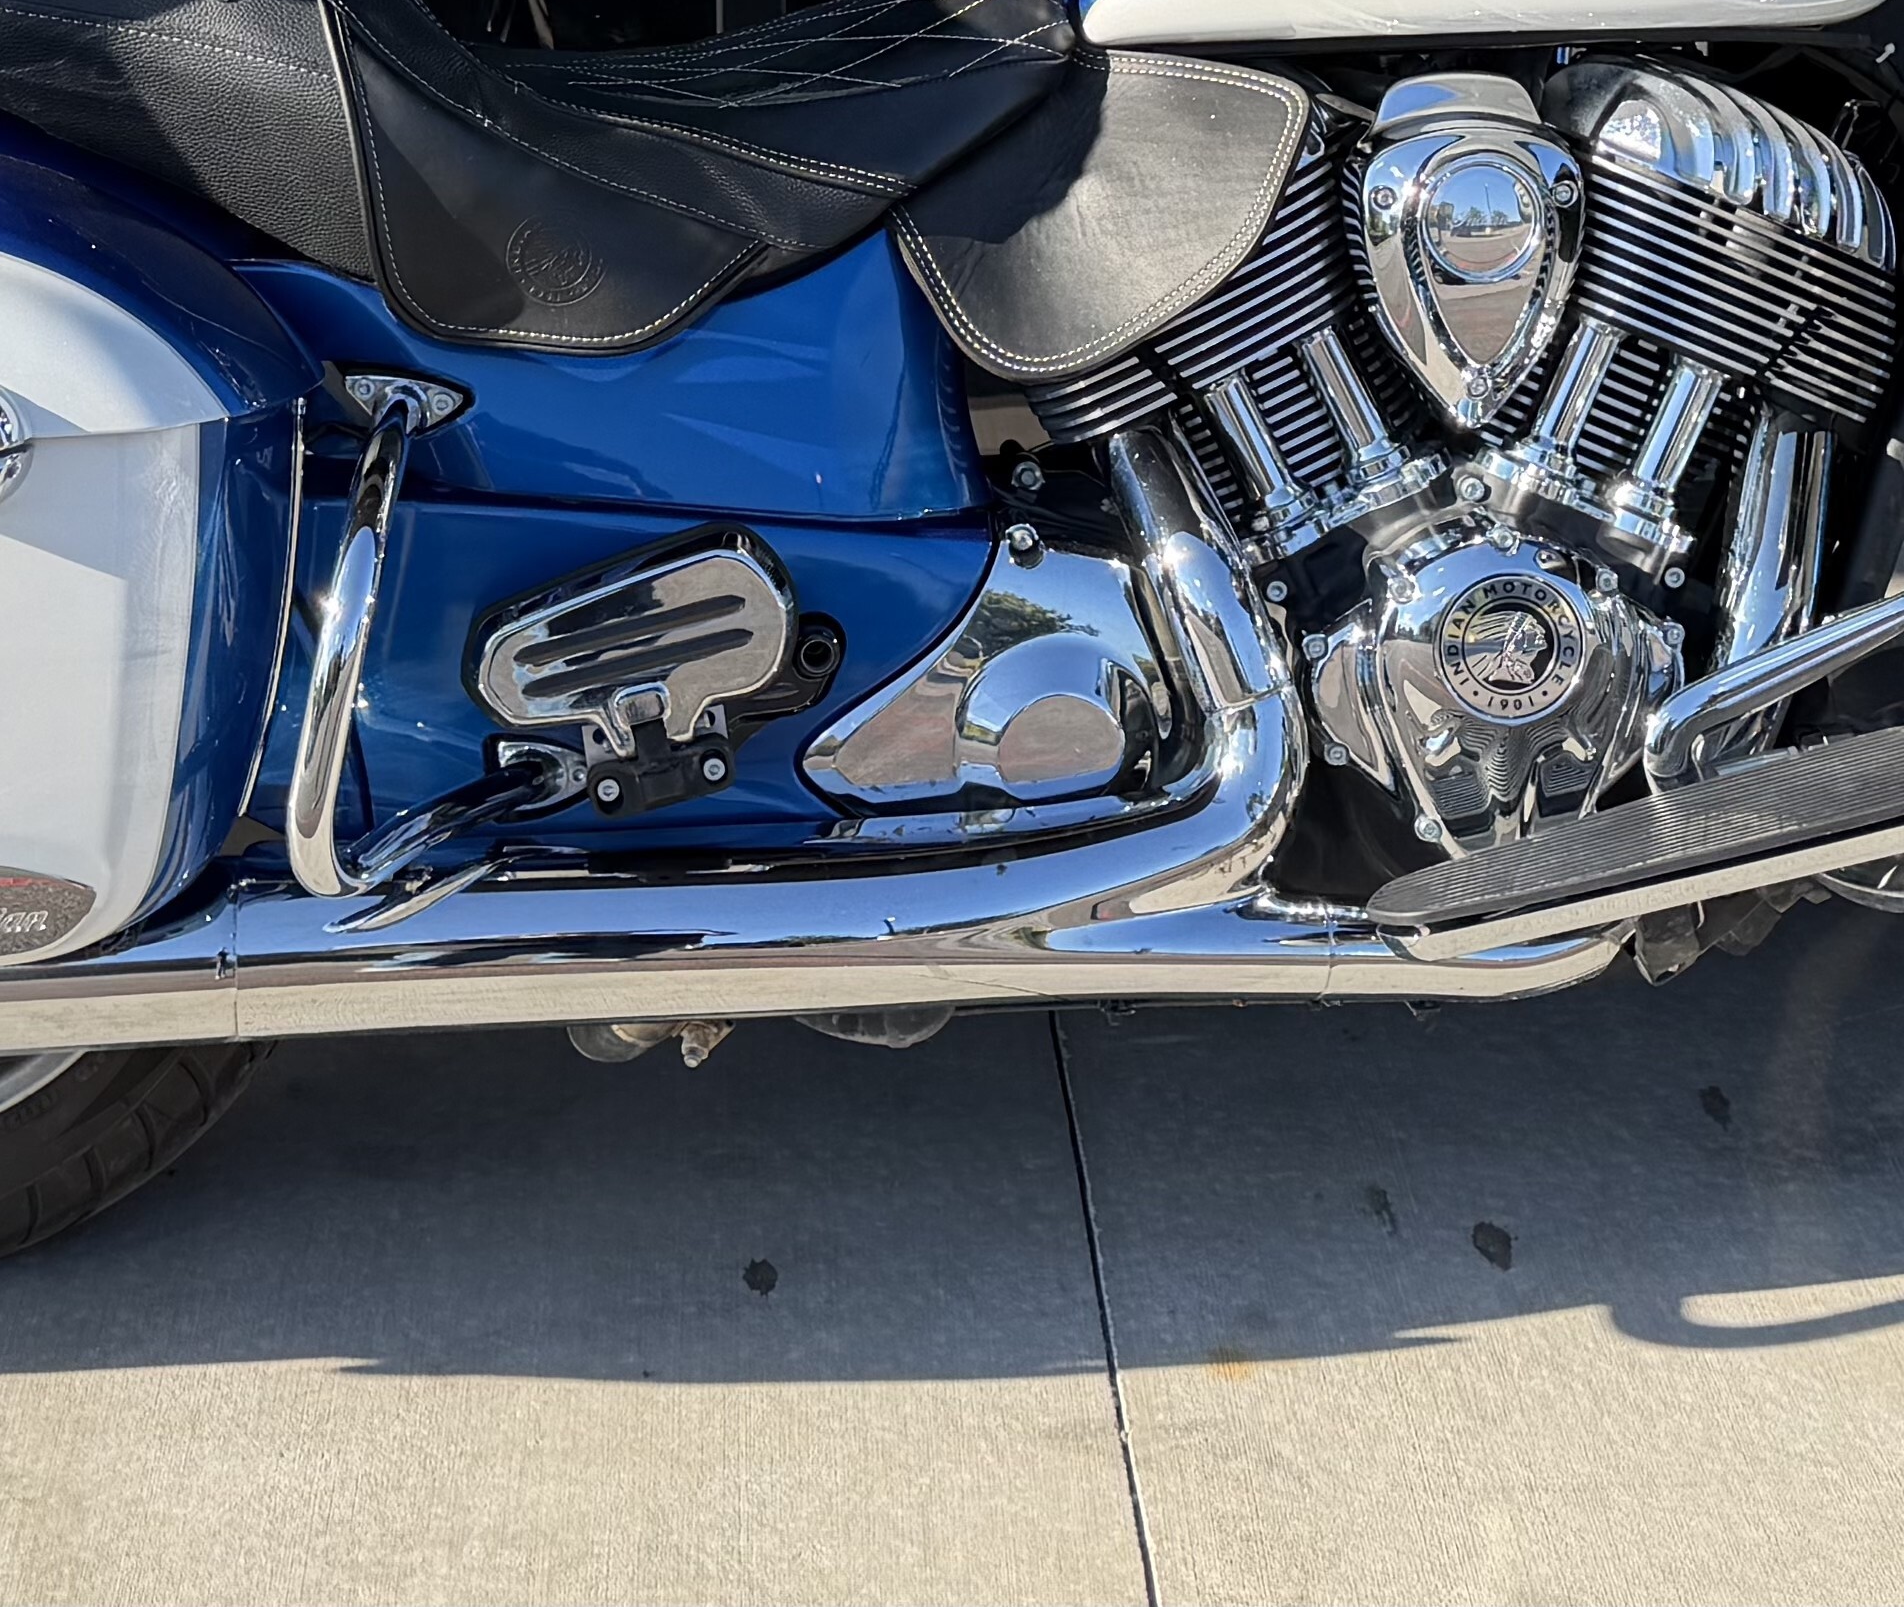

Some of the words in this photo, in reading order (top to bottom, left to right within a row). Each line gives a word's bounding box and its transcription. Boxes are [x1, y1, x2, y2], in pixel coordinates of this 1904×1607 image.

[1446, 599, 1477, 686] INDIAN
[1483, 581, 1575, 686] MOTORCYCLE
[1487, 695, 1534, 711] 1901
